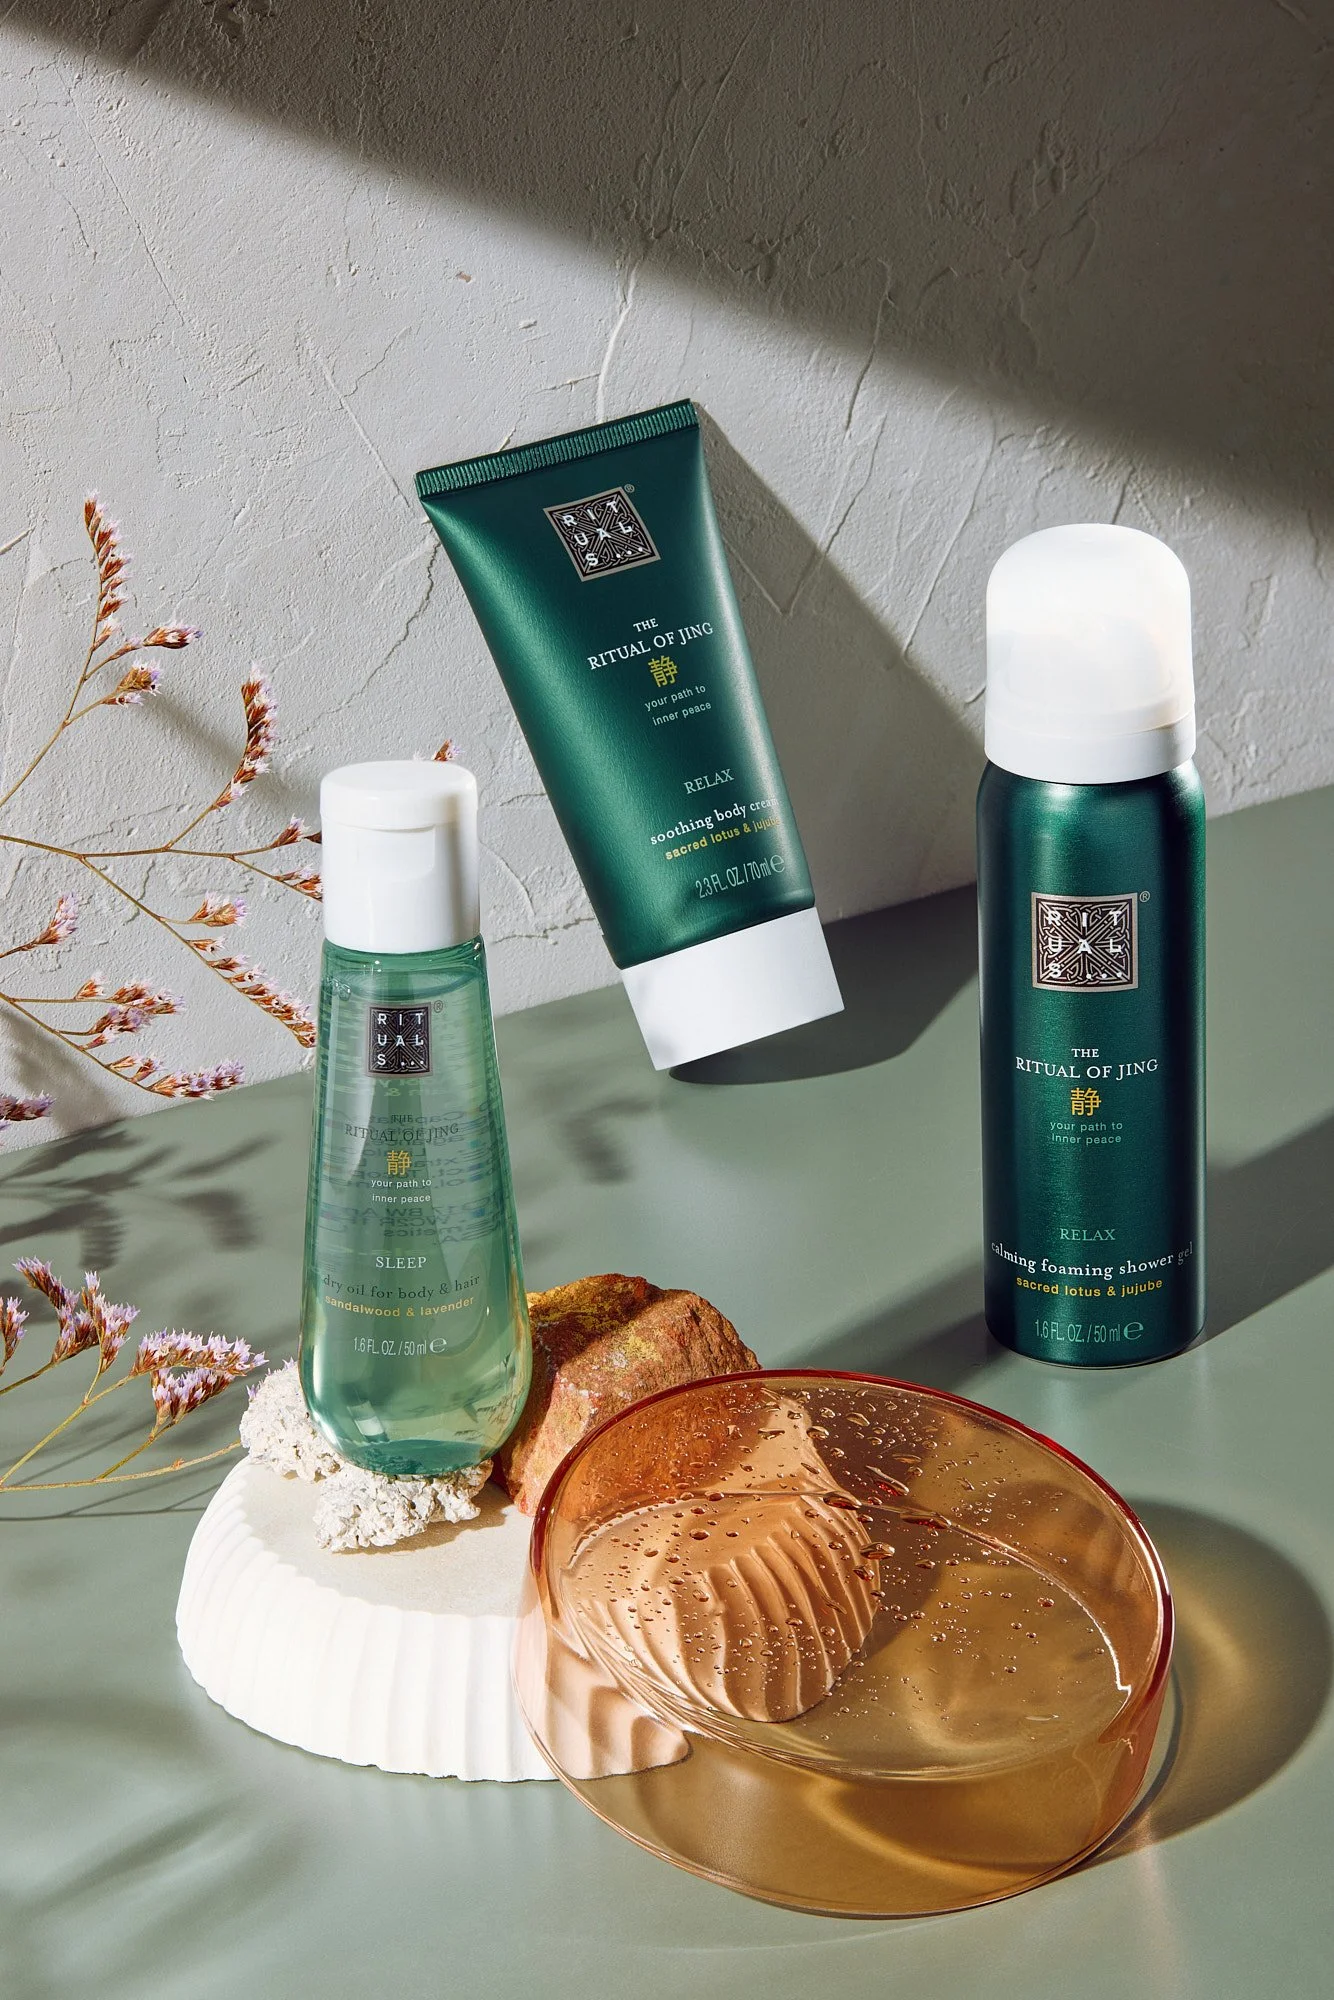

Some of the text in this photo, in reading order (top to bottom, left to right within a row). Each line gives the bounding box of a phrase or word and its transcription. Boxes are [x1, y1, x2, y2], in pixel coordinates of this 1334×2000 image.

[633, 618, 658, 632] THE
[587, 622, 713, 670] RITUAL OF JING
[648, 656, 677, 687] 静
[645, 685, 706, 711] your path to
[652, 702, 711, 726] inner peace
[684, 769, 734, 794] RELAX
[651, 816, 714, 845] soothing
[714, 803, 746, 821] body
[665, 836, 708, 860] sacred
[711, 827, 740, 843] lotus
[743, 823, 751, 833] &
[1071, 1049, 1099, 1058] THE
[1016, 1057, 1159, 1081] RITUAL OF JING
[1070, 1088, 1101, 1116] 静
[392, 1115, 412, 1123] THE
[1050, 1122, 1123, 1132] your path to
[345, 1123, 459, 1142] RITUAL OF JING
[1052, 1134, 1121, 1146] inner peace
[387, 1150, 411, 1175] 静
[371, 1179, 392, 1188] your
[397, 1180, 418, 1189] path
[372, 1194, 431, 1204] inner peace
[1060, 1228, 1116, 1241] RELAX
[376, 1257, 426, 1269] SLEEP
[991, 1241, 1193, 1280] calming foaming shower gel
[323, 1275, 480, 1301] dry oil for body & hair
[1016, 1276, 1163, 1297] sacred lotus & jujube
[325, 1295, 474, 1317] sandalwood & lavender
